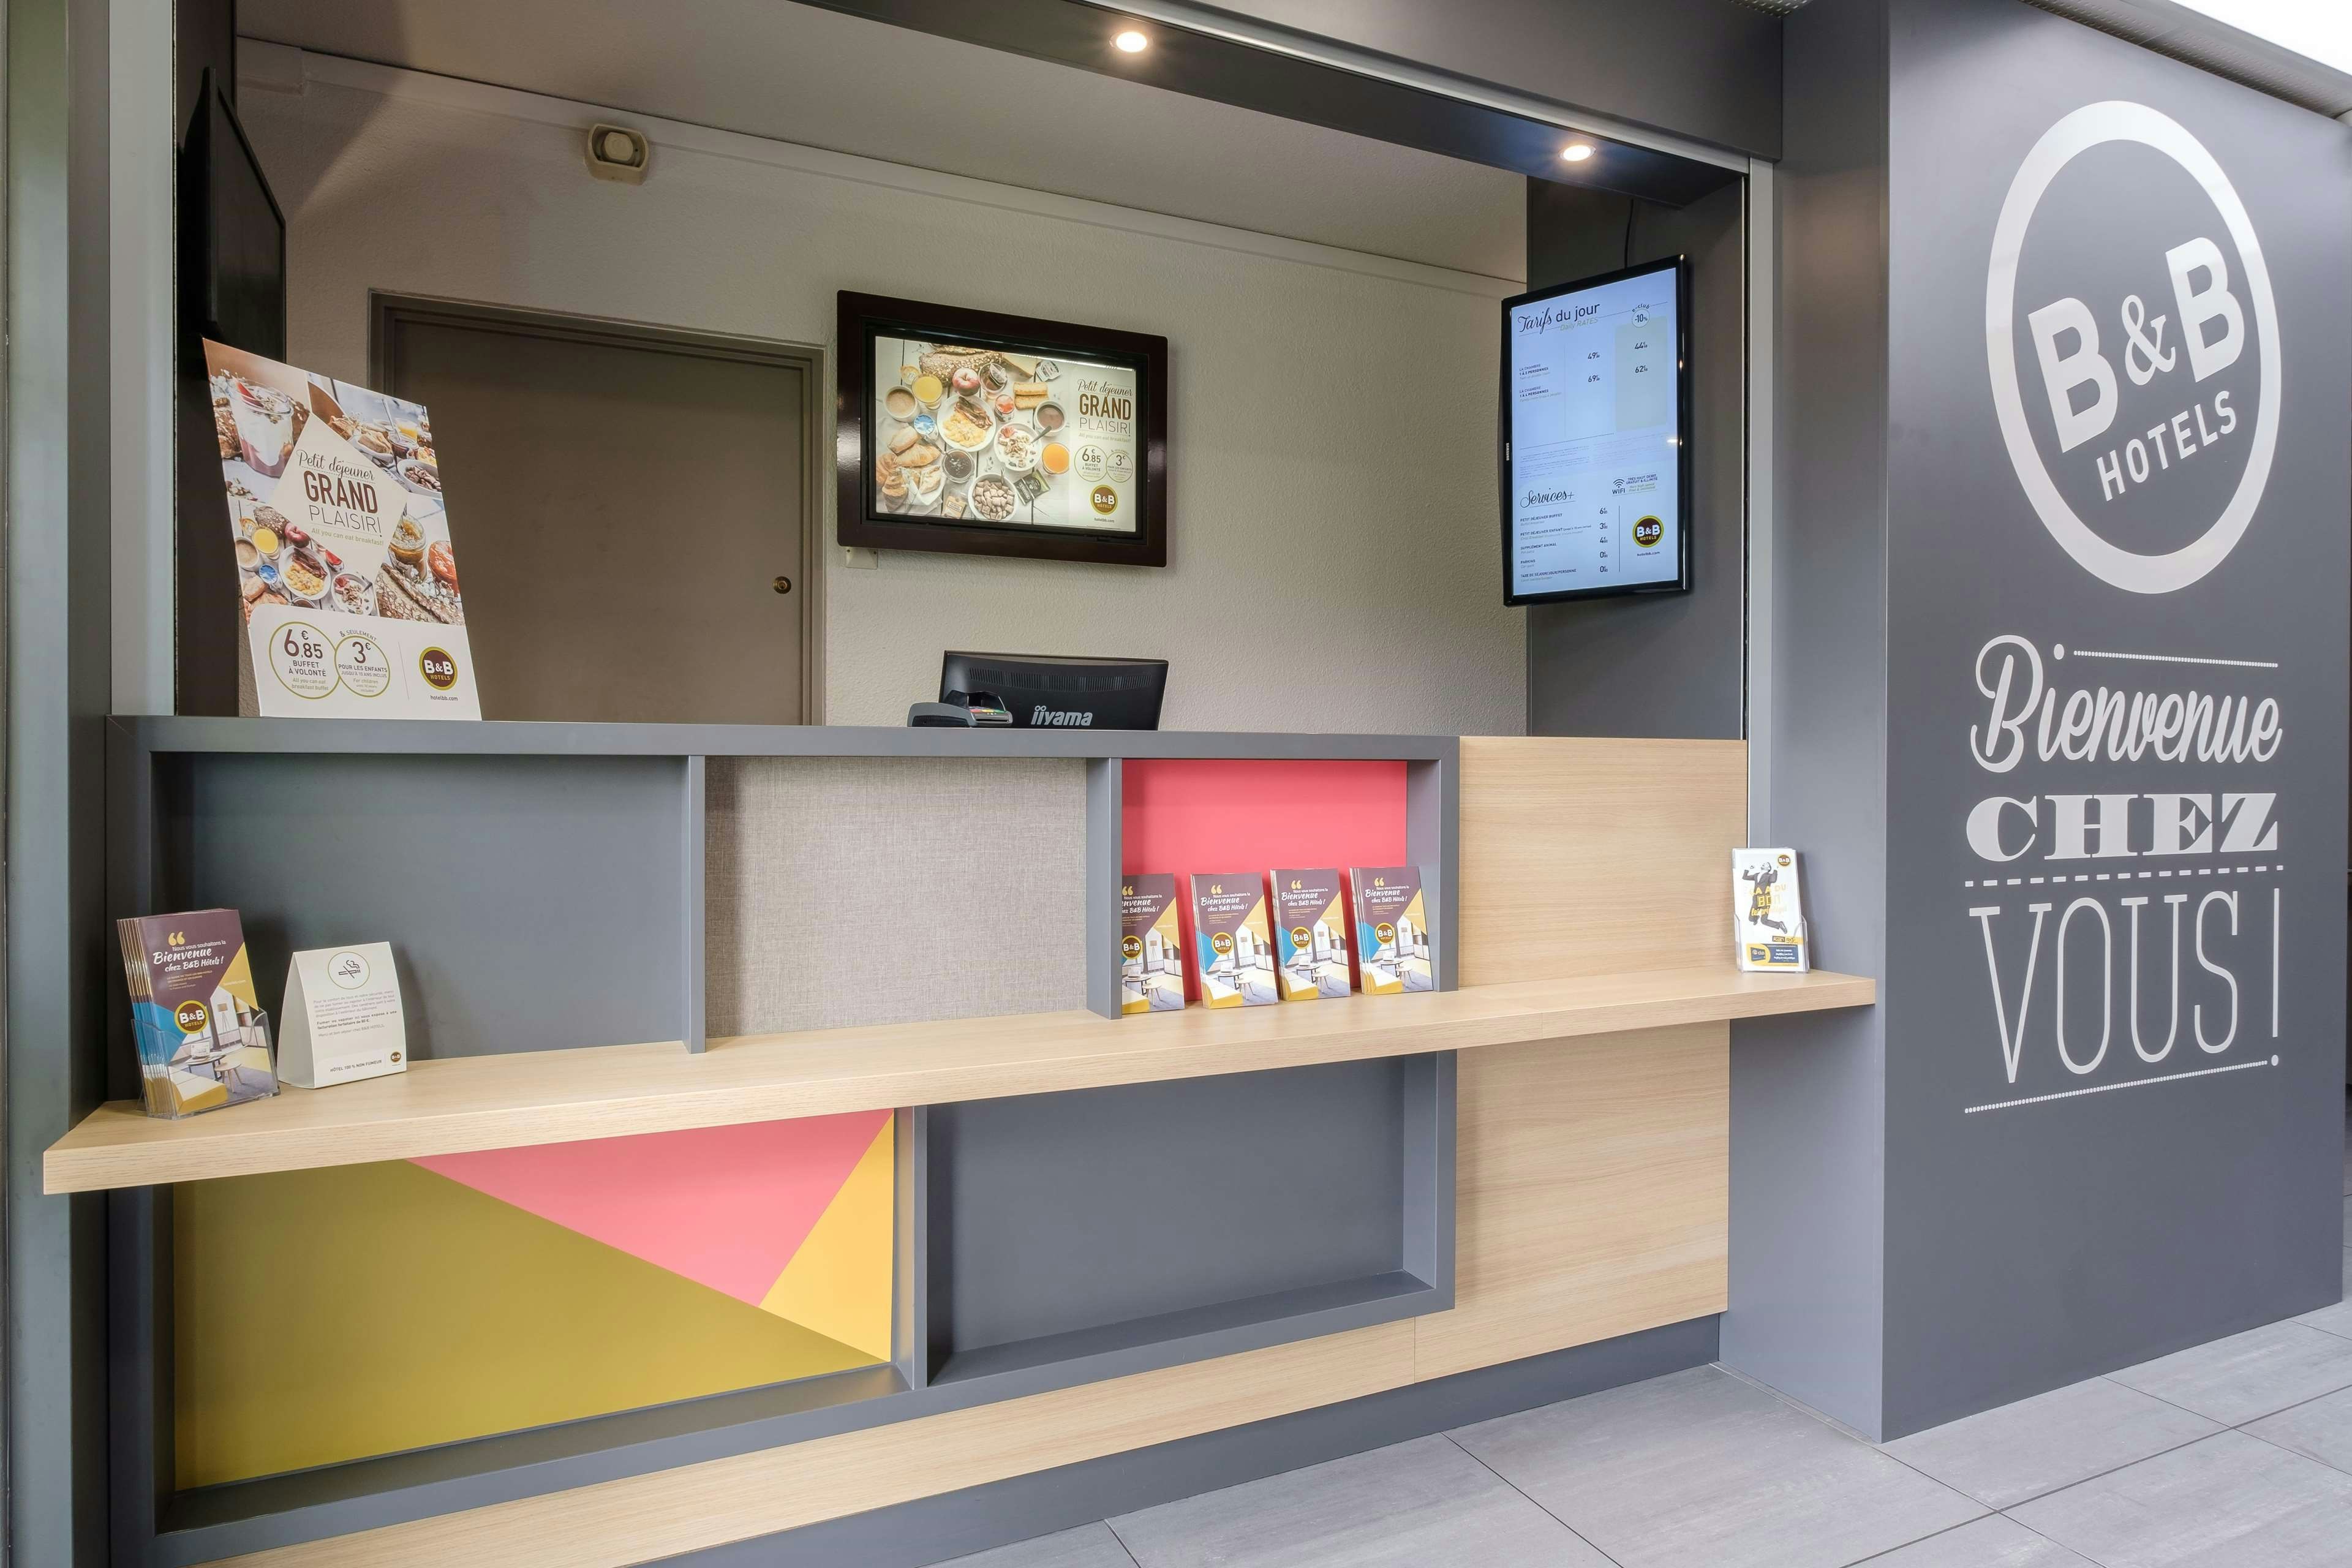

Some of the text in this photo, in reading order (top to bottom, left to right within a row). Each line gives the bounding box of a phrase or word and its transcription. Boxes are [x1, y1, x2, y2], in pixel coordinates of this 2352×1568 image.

[1518, 304, 1600, 334] Tarifs du jour
[1577, 318, 1598, 326] RATES
[2028, 237, 2245, 453] B&B
[1077, 379, 1133, 397] Petit déjeuner
[1079, 393, 1131, 420] GRAND
[1080, 417, 1131, 437] PLAISIR!
[2096, 391, 2237, 502] HOTELS
[296, 449, 375, 481] Petit déjeuner
[303, 470, 378, 514] GRAND
[1095, 494, 1115, 505] B&B
[309, 505, 382, 537] PLAISIR!
[1637, 524, 1660, 537] B&B
[346, 630, 377, 641] SEULEMENT
[288, 666, 294, 674] À
[424, 660, 453, 675] B&B
[1970, 634, 2283, 773] Bienvenue
[1031, 706, 1093, 726] iiyama
[1966, 793, 2278, 862] CHEZ
[1200, 897, 1240, 906] Bienvenue
[1281, 892, 1318, 901] Bienvenue
[1365, 889, 1400, 898] Bienvenue
[1215, 939, 1231, 948] B&B
[1294, 933, 1309, 942] B&B
[153, 948, 212, 965] Bienvenue
[165, 963, 181, 972] chez
[183, 960, 200, 970] B&B
[201, 956, 220, 967] Hôtels
[1969, 890, 2239, 1083] VOUS
[179, 1009, 205, 1024] B&B
